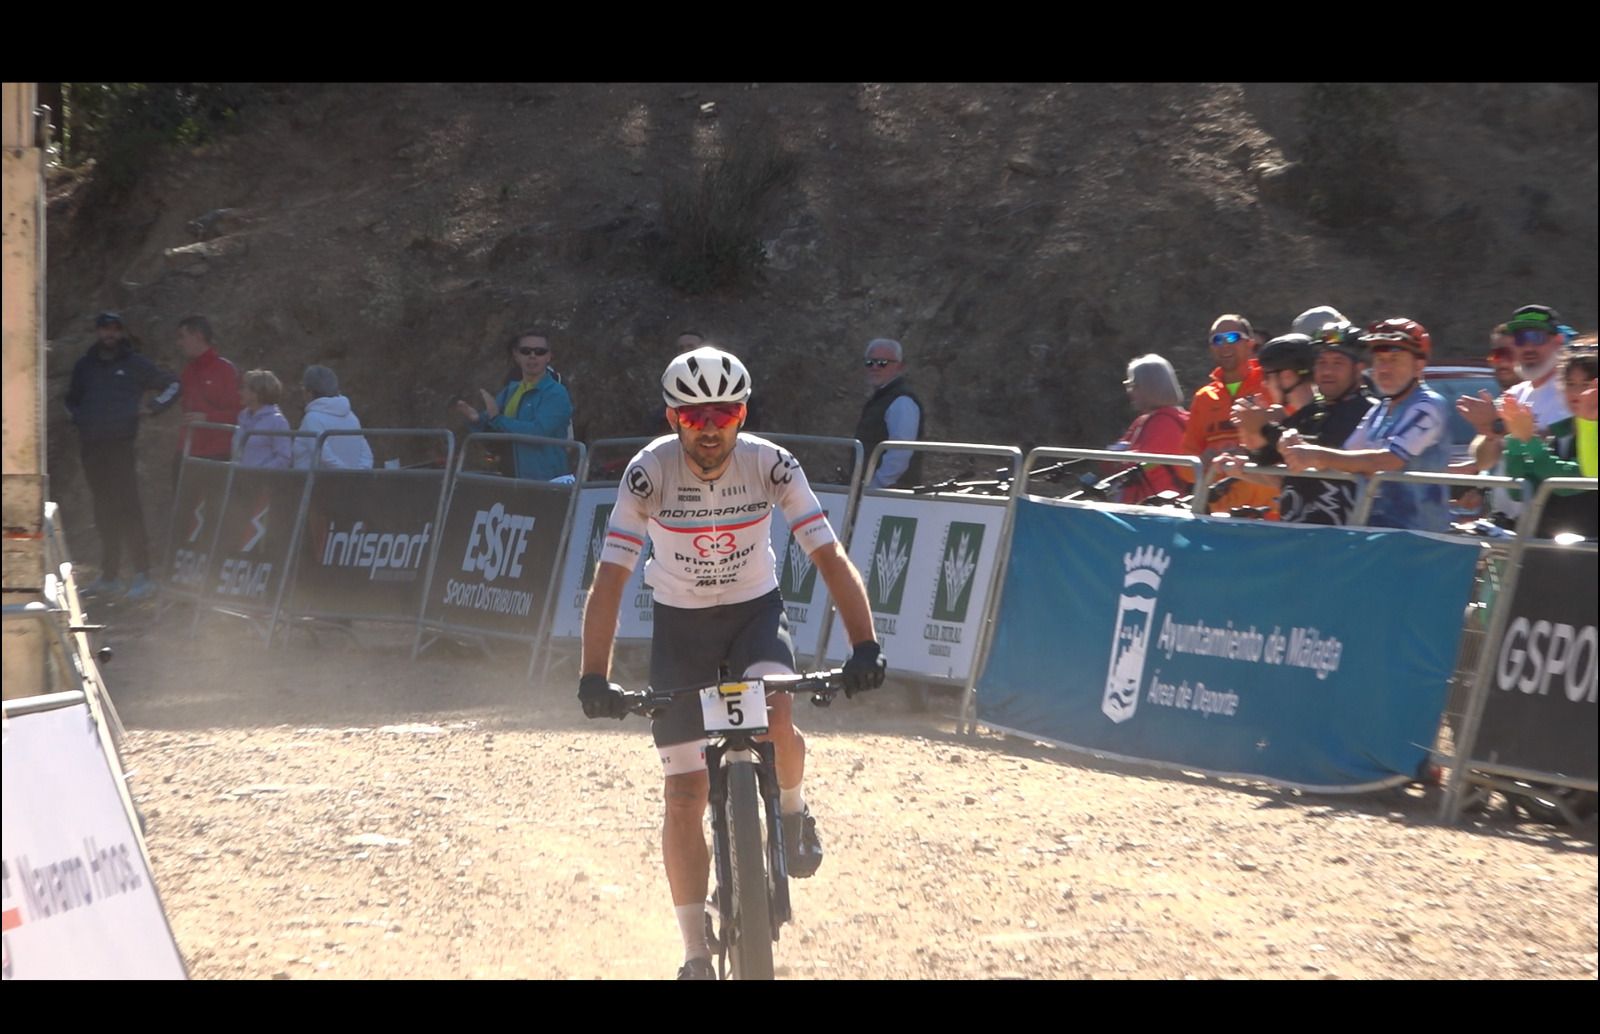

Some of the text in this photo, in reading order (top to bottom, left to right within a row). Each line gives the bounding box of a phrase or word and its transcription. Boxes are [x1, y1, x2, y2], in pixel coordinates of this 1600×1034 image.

[658, 500, 769, 519] MONDRAKER
[322, 520, 432, 580] infisport
[1156, 612, 1264, 662] Ayuntamiento
[1263, 625, 1287, 665] de
[1175, 679, 1193, 710] de
[726, 700, 744, 726] 5
